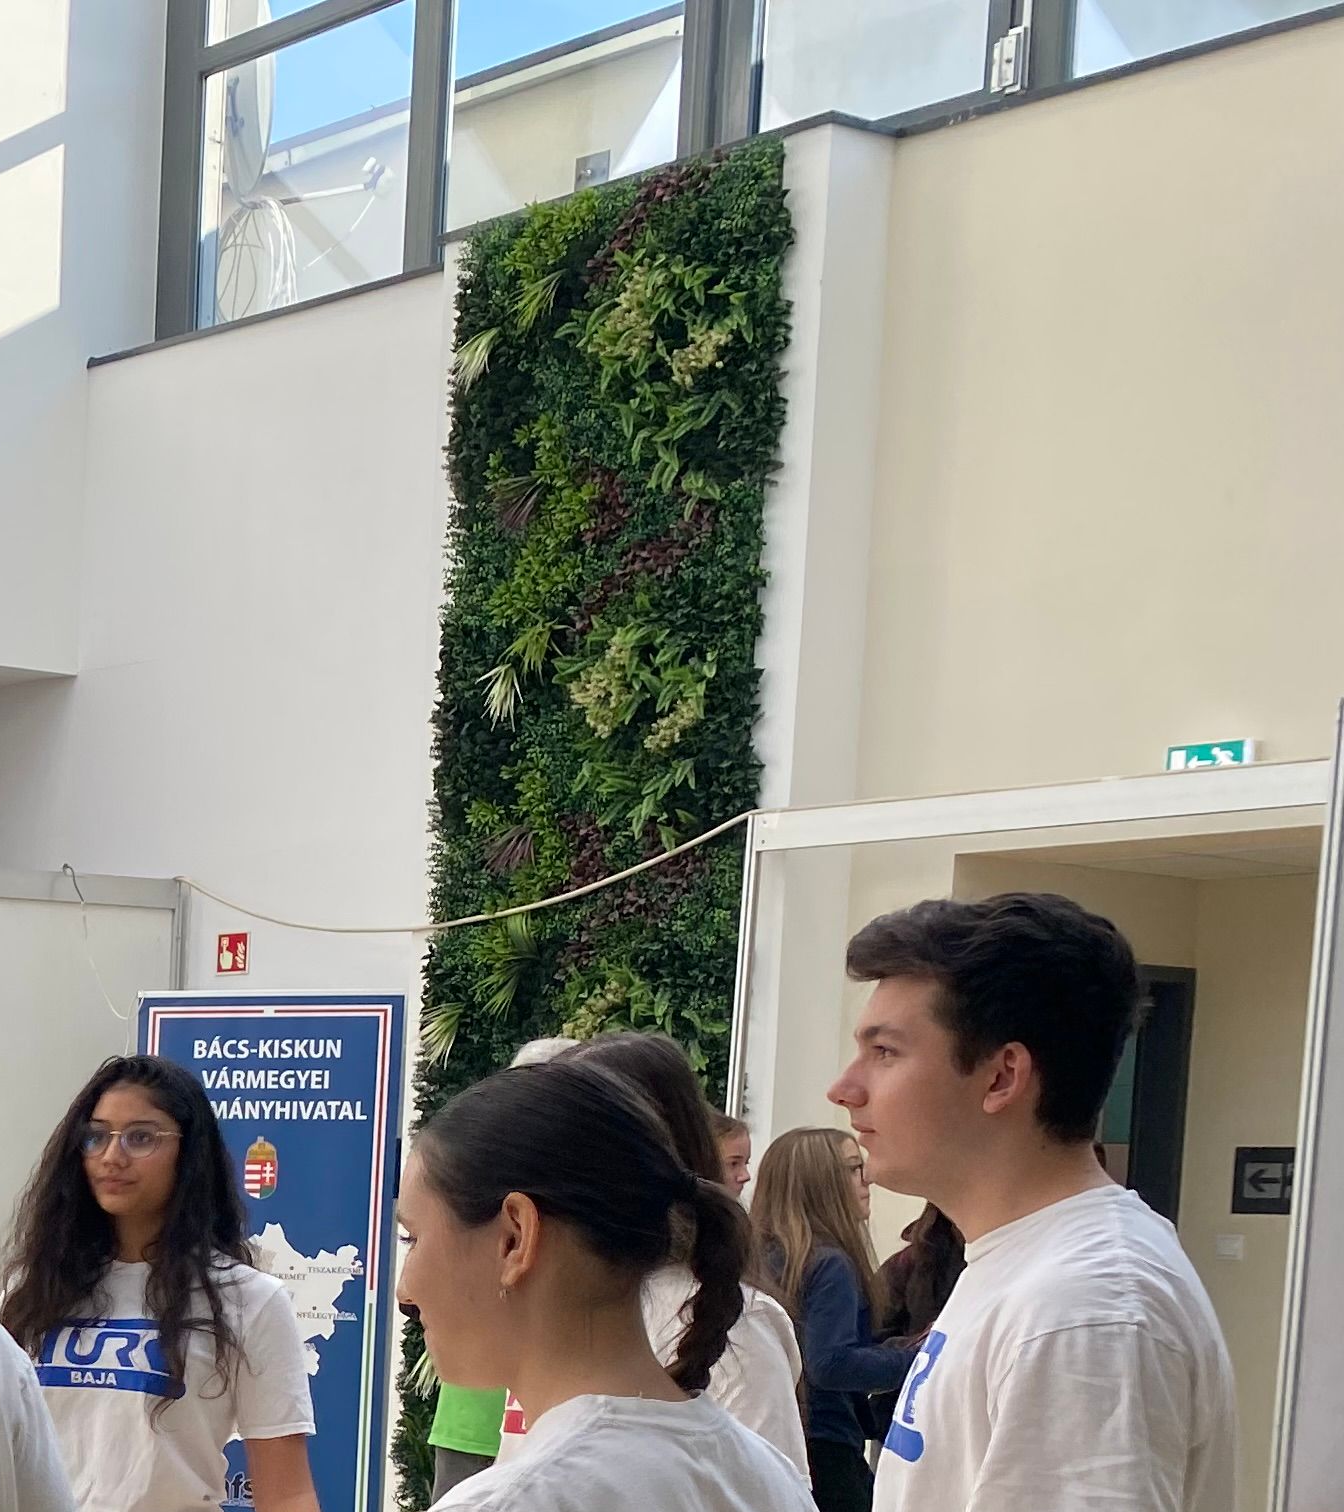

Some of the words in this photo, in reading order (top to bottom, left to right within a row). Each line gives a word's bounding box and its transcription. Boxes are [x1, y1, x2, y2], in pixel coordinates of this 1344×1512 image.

[193, 1035, 342, 1059] BÁCS-KISKUN
[201, 1066, 330, 1090] VÁRMEGYEI
[70, 1370, 118, 1386] BAJA
